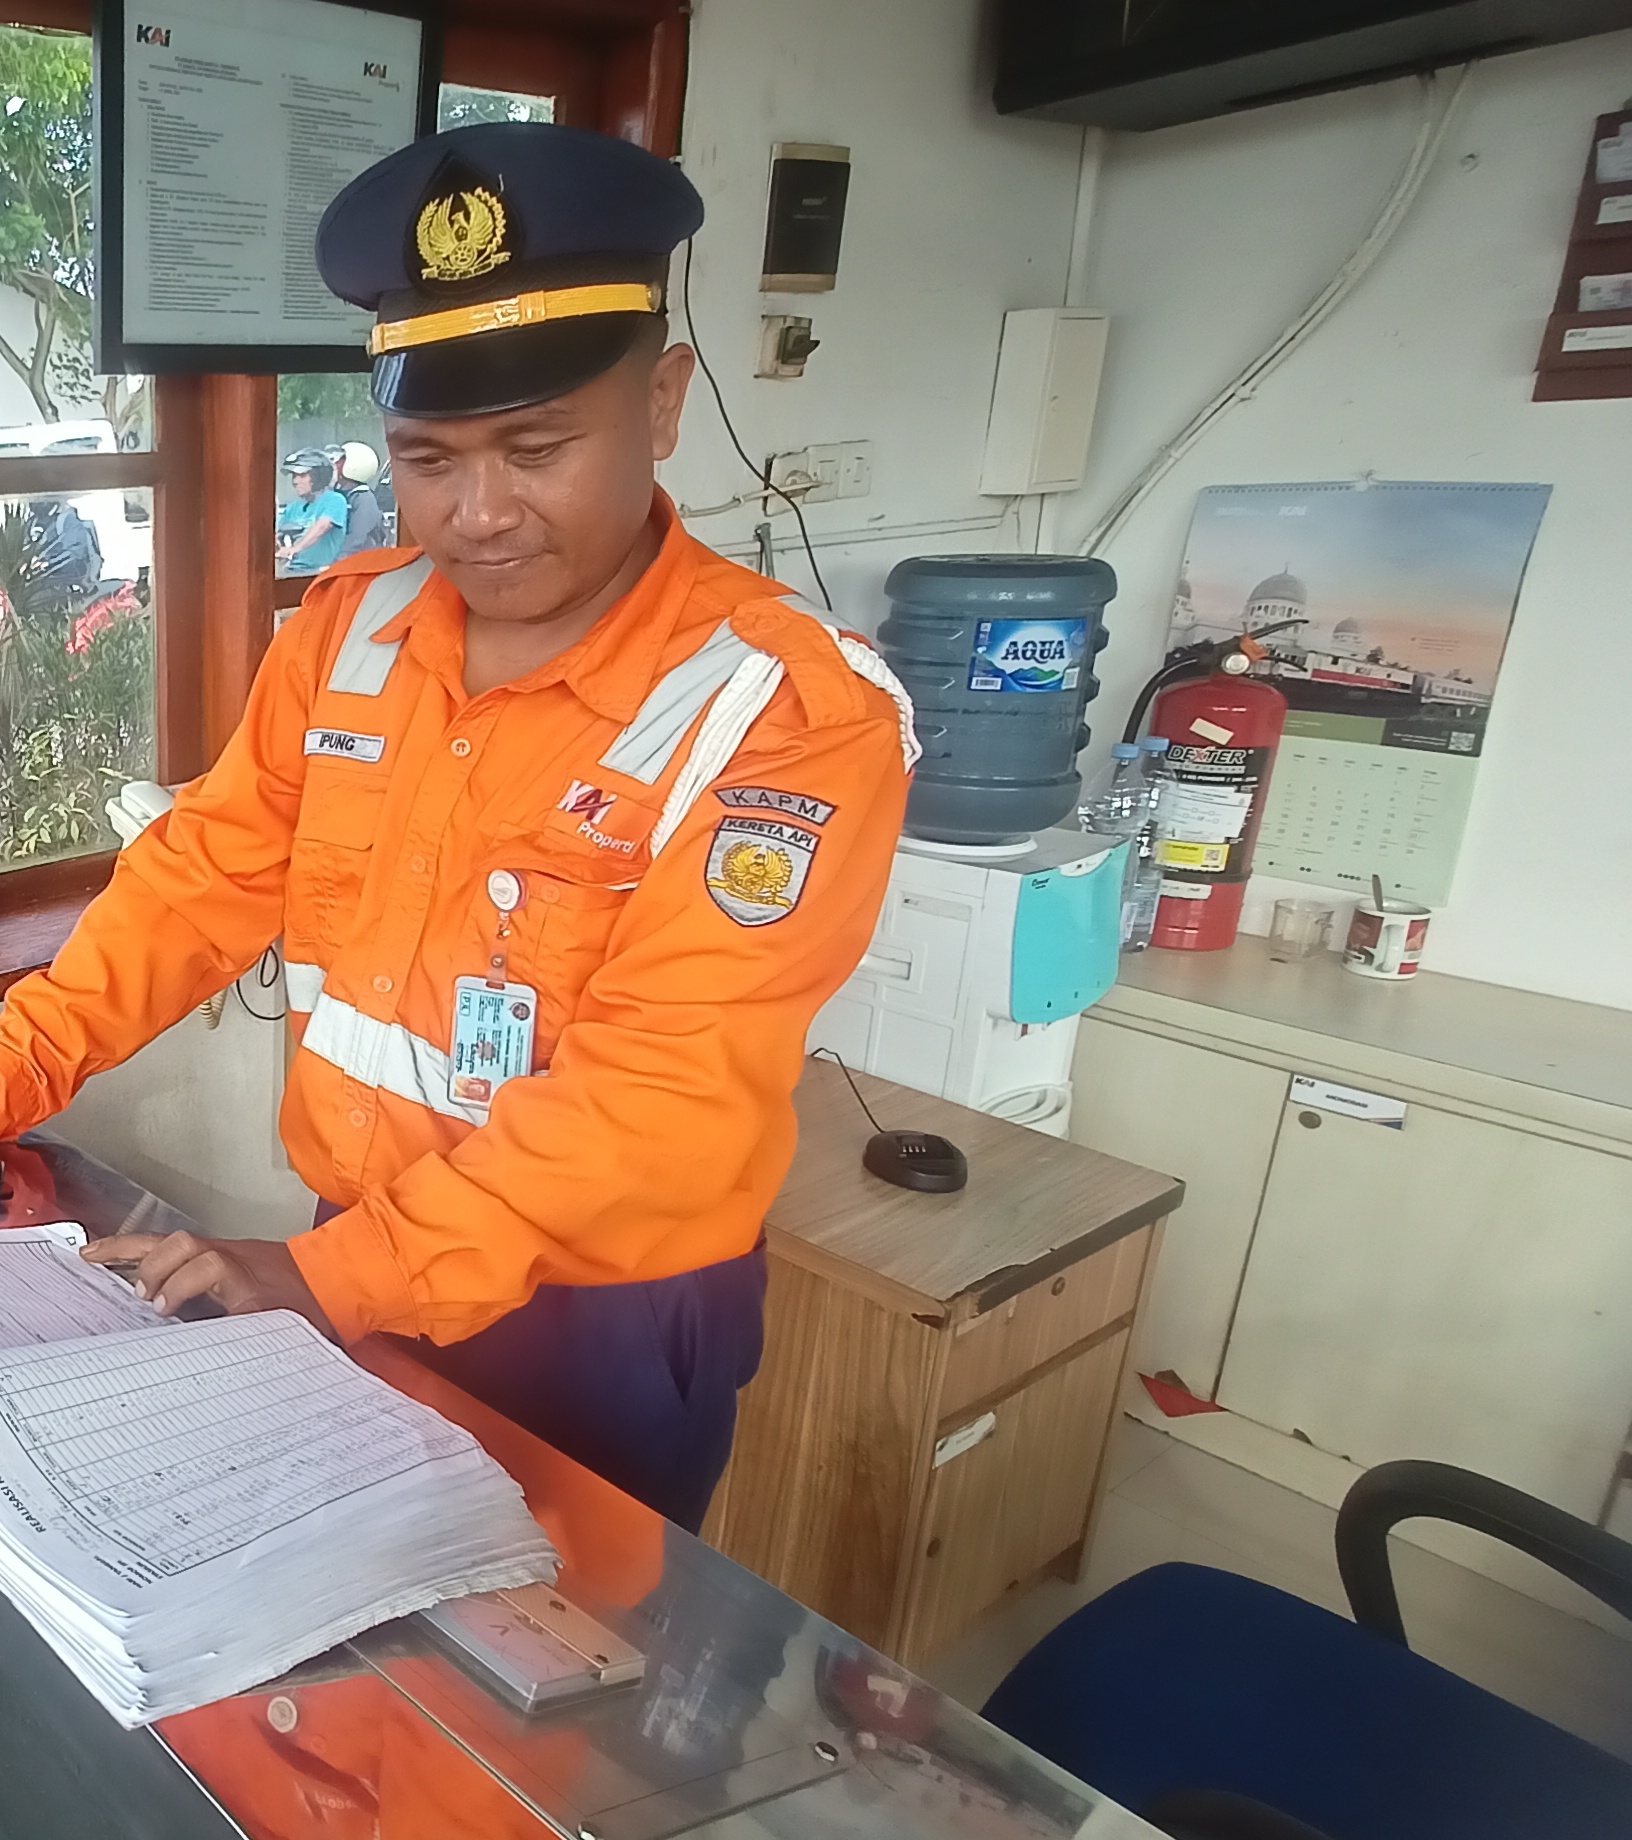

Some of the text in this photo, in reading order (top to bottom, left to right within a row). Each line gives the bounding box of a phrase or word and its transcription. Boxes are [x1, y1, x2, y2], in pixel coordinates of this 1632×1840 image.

[136, 24, 171, 48] KAI
[363, 62, 387, 79] KAI
[1001, 639, 1066, 664] AQUA
[319, 733, 356, 751] IPUNG
[1168, 745, 1248, 765] DEXTER
[556, 779, 617, 825] KAI
[727, 819, 817, 848] KERETA API
[0, 1486, 47, 1533] REALISASI
